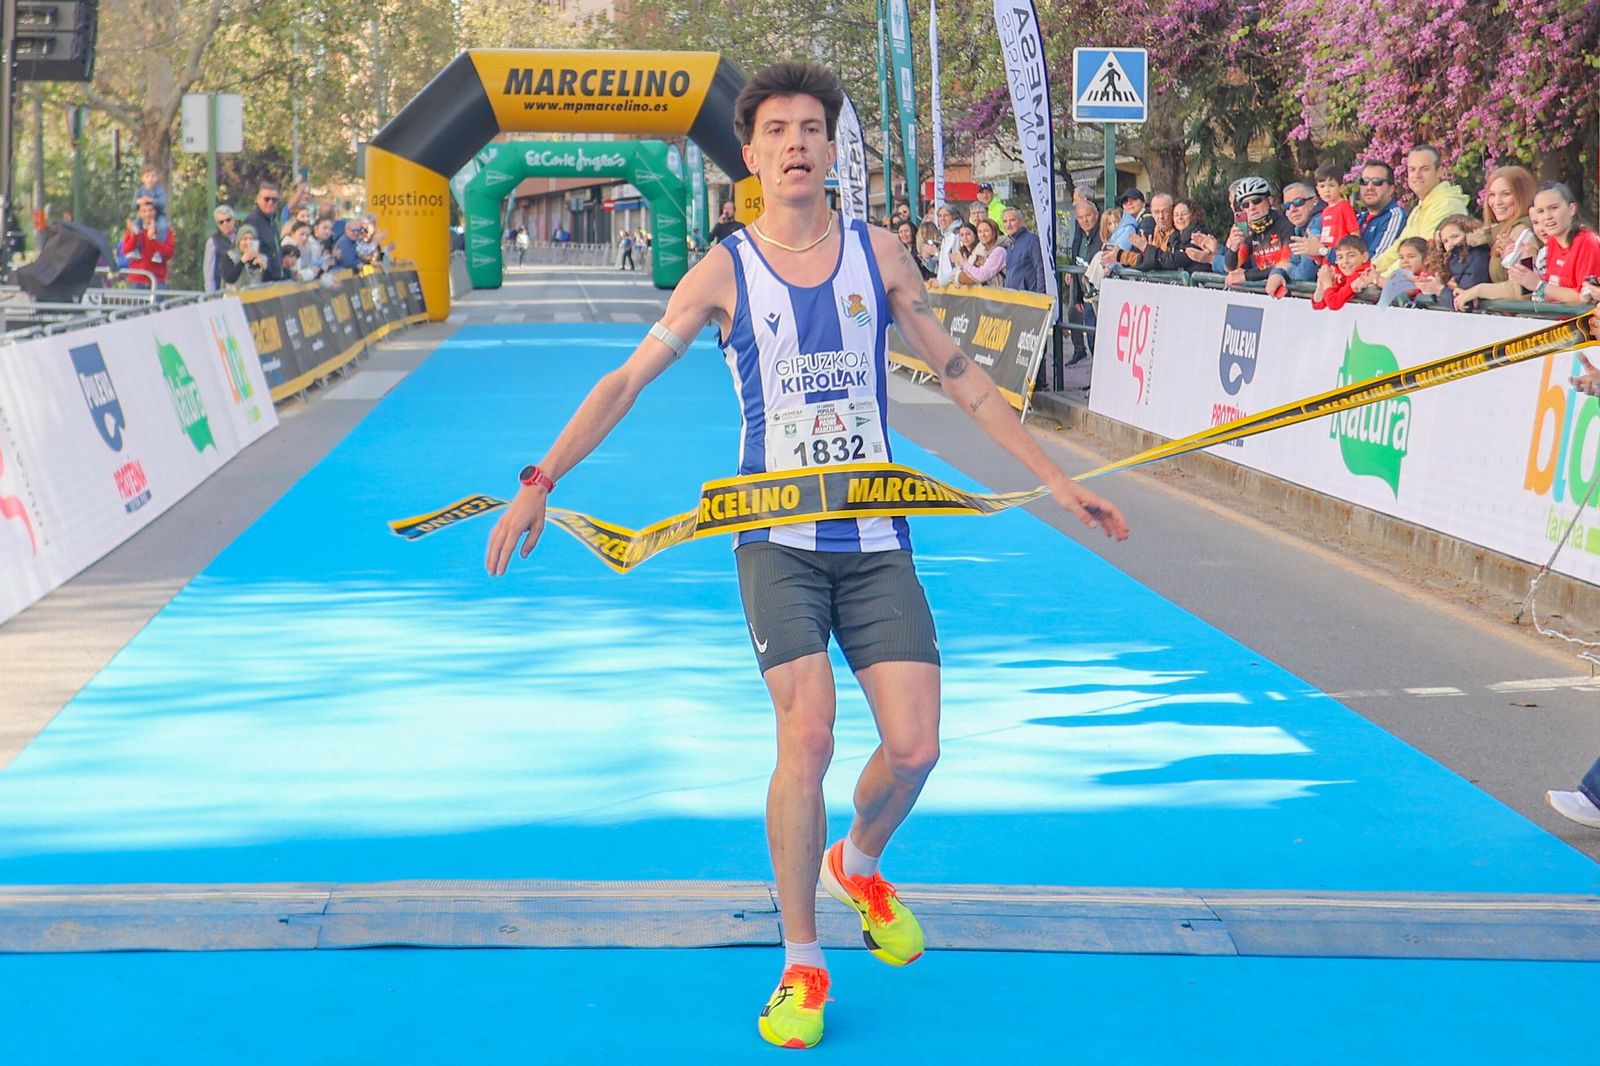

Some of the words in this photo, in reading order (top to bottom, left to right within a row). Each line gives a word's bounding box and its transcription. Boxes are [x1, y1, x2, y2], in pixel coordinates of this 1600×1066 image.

[503, 67, 691, 98] MARCELINO
[523, 99, 669, 114] www.mpmarcelino.es
[525, 149, 541, 167] El
[540, 150, 576, 167] Corte
[371, 190, 443, 210] agustinos
[1222, 323, 1258, 360] PULEVA
[1504, 324, 1575, 362] MARCELINO
[775, 351, 870, 377] GIPUZKOA
[1414, 352, 1489, 388] MARCELINO
[780, 369, 868, 395] KIROLAK
[793, 434, 867, 467] 1832
[699, 483, 801, 523] RCELINO
